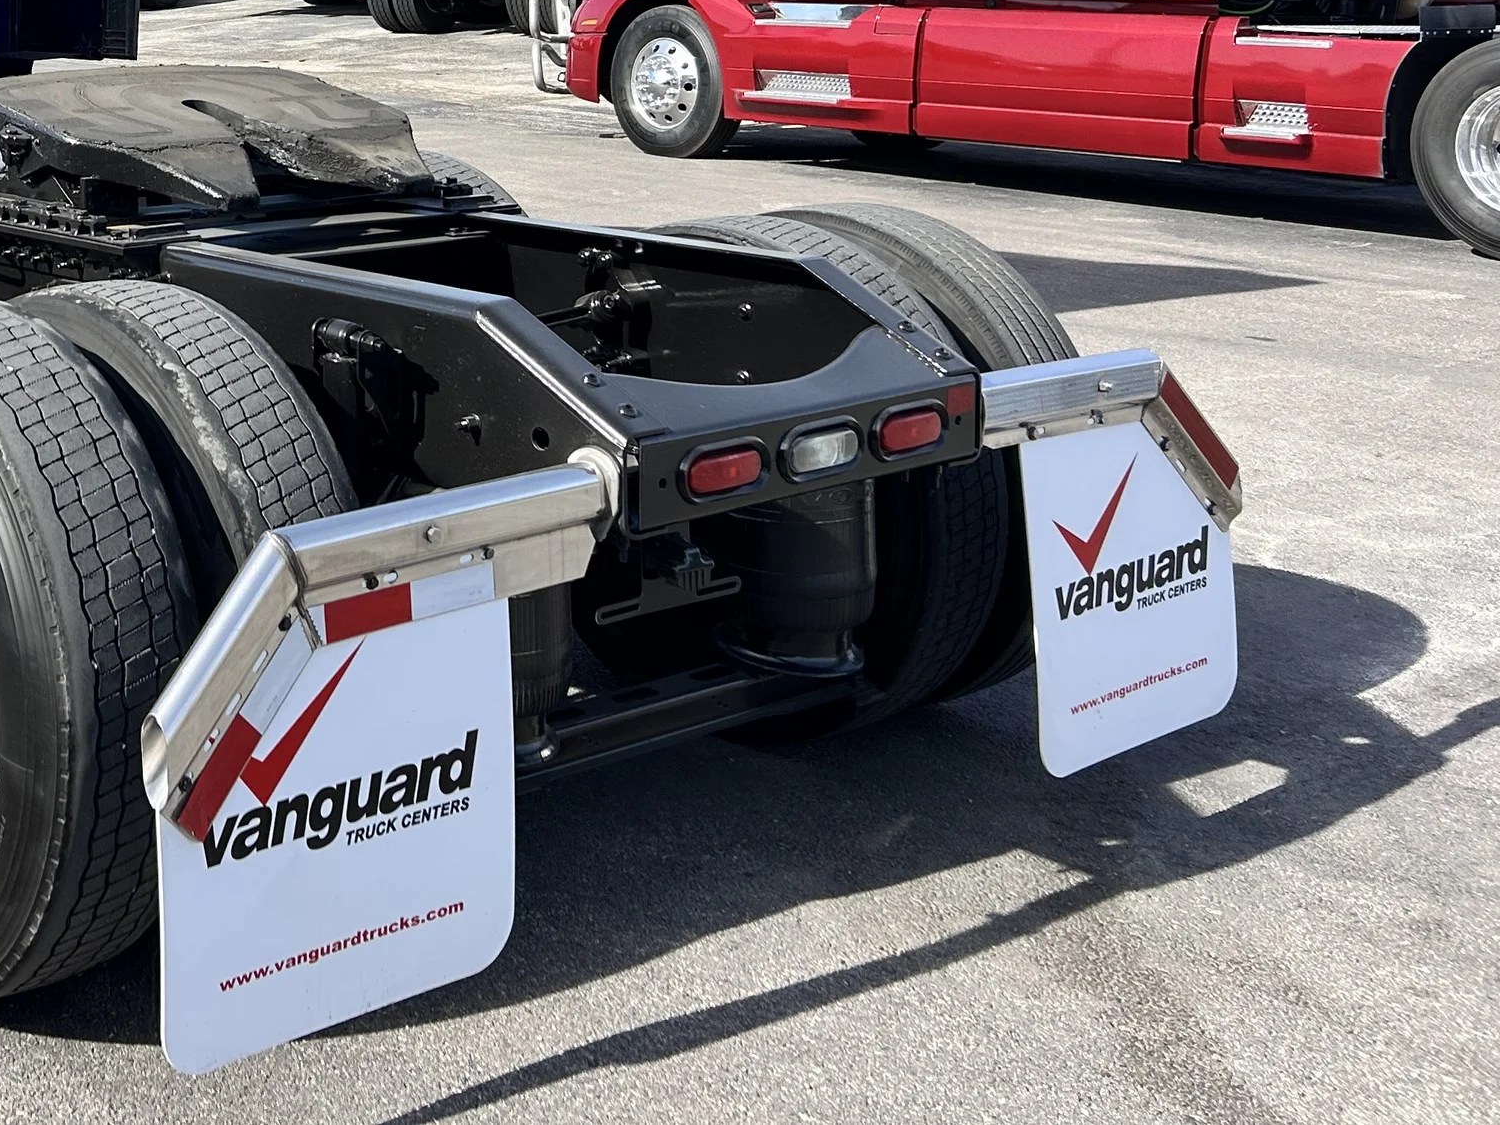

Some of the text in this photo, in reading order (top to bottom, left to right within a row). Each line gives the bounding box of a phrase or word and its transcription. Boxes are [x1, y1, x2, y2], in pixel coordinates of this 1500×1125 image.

[1056, 525, 1209, 621] vanguard
[1136, 576, 1208, 610] TRUCK CENTERS
[1070, 657, 1209, 716] www.vanguardtrucks.com
[202, 729, 480, 868] vanguard
[346, 796, 471, 847] TRUCK CENTERS
[218, 900, 465, 993] www.vanguardtrucks.com
